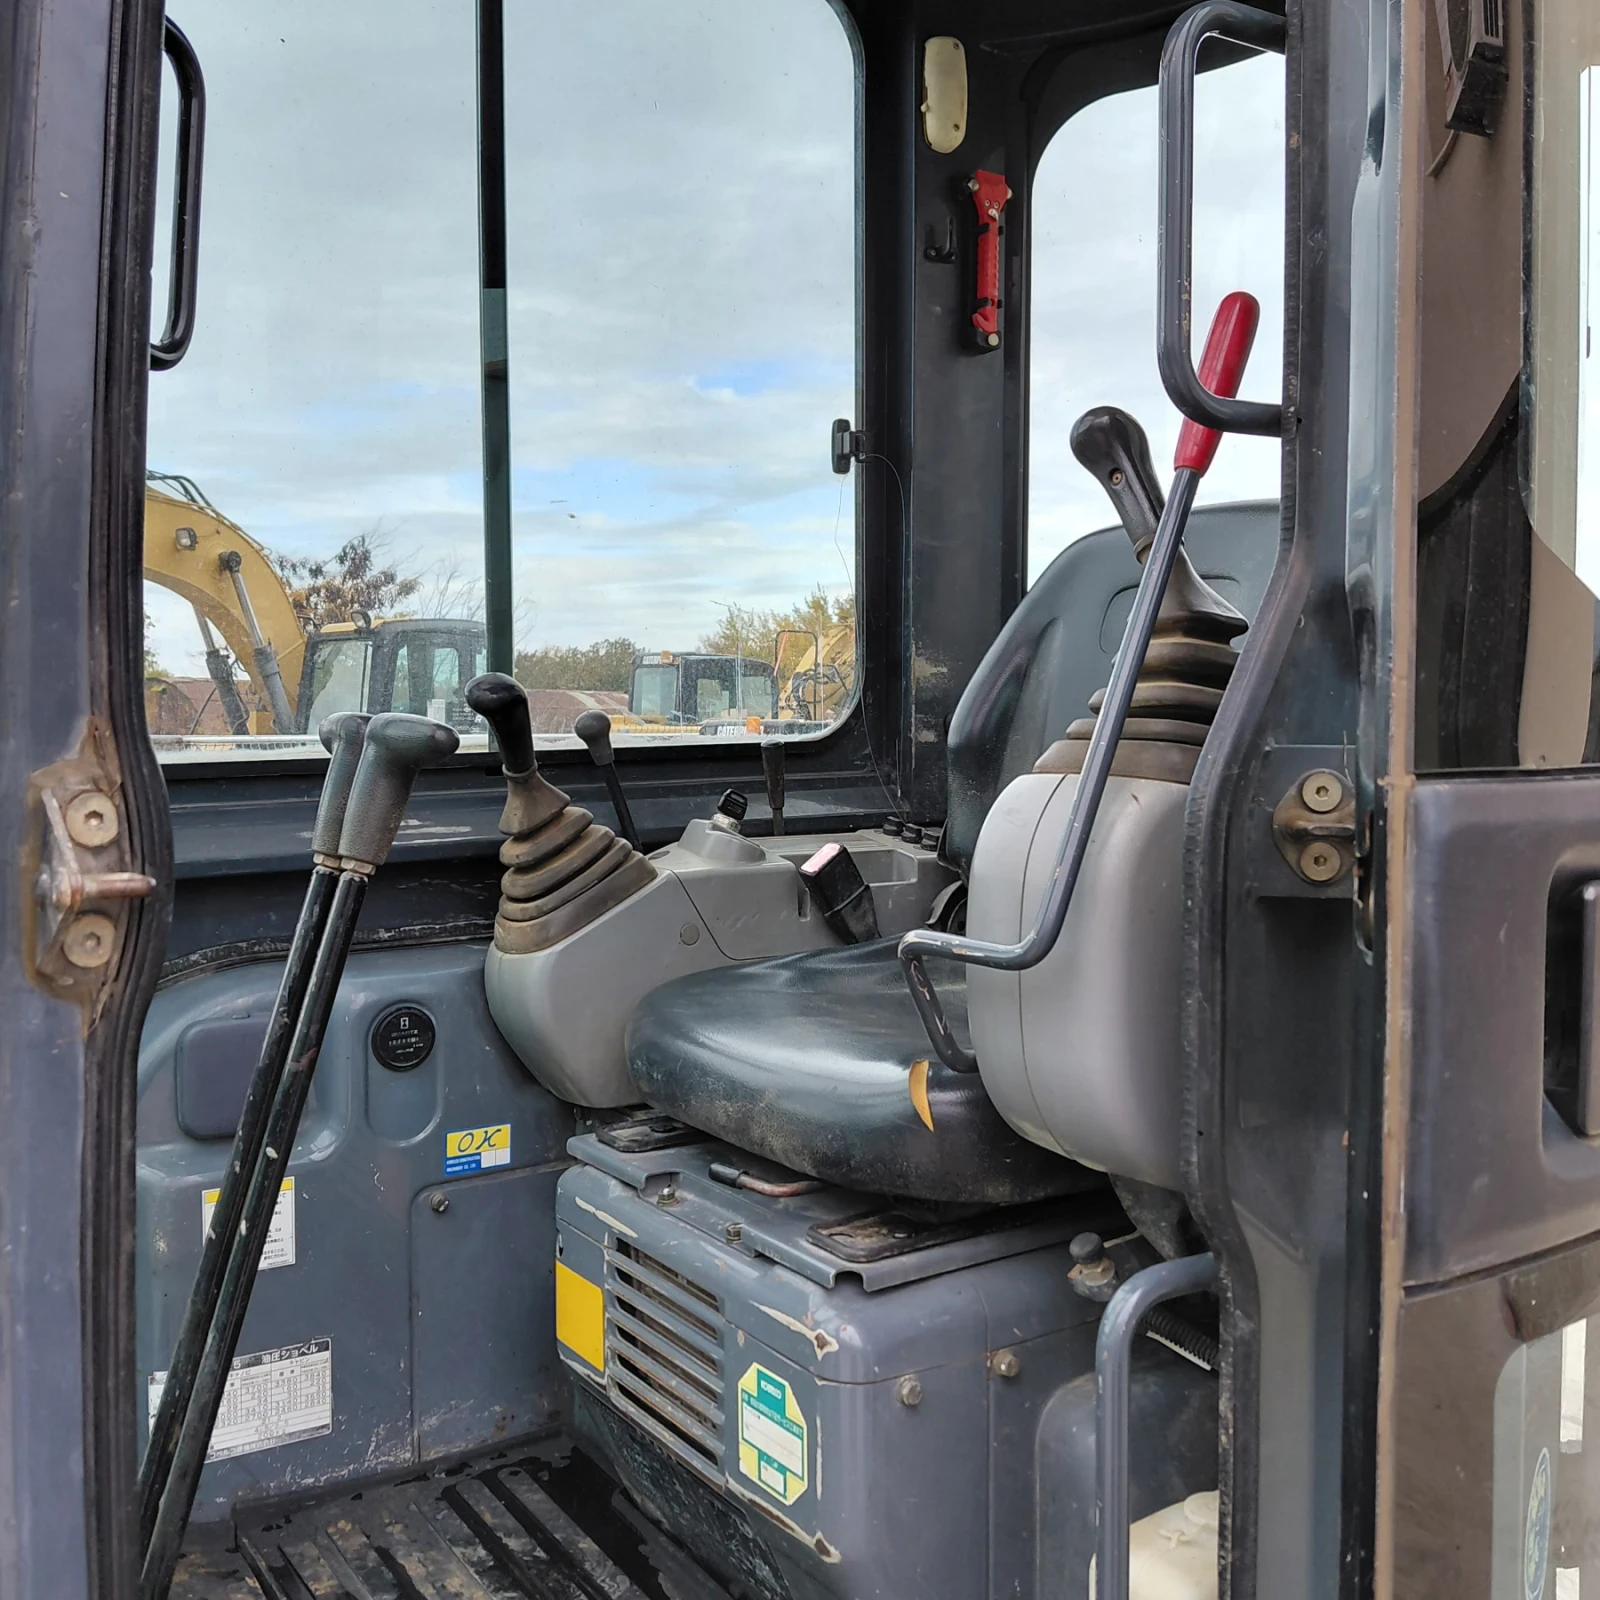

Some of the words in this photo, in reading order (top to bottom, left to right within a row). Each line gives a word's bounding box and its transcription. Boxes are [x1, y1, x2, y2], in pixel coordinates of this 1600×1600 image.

[457, 1128, 502, 1153] OK
[261, 1343, 319, 1364] 油圧ショベル
